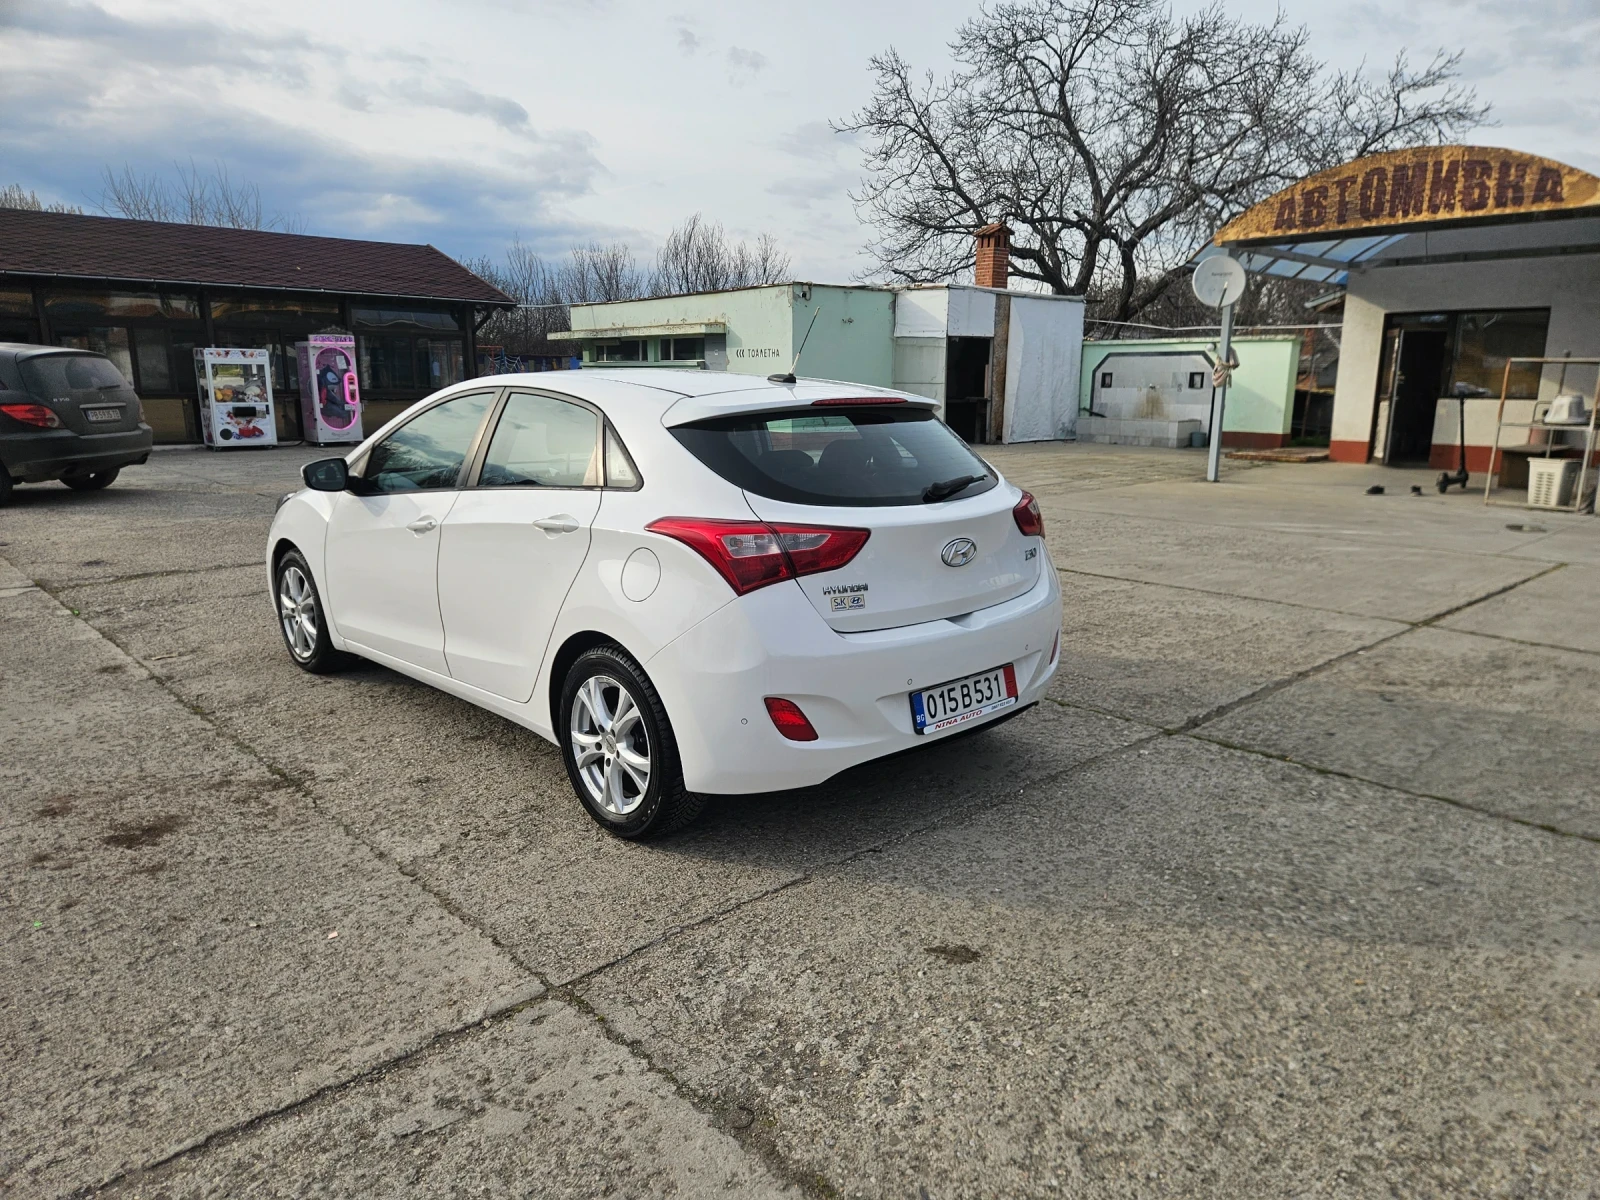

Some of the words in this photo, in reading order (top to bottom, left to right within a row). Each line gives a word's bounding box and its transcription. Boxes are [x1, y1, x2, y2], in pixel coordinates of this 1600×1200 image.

[1273, 159, 1565, 231] АВТОМИВКА
[748, 348, 780, 358] ТОАЛЕТНА
[822, 583, 869, 596] HYUNDAI
[926, 673, 1002, 719] 015B531
[916, 714, 925, 722] BG
[934, 718, 959, 730] NINA
[960, 709, 983, 722] AUTO
